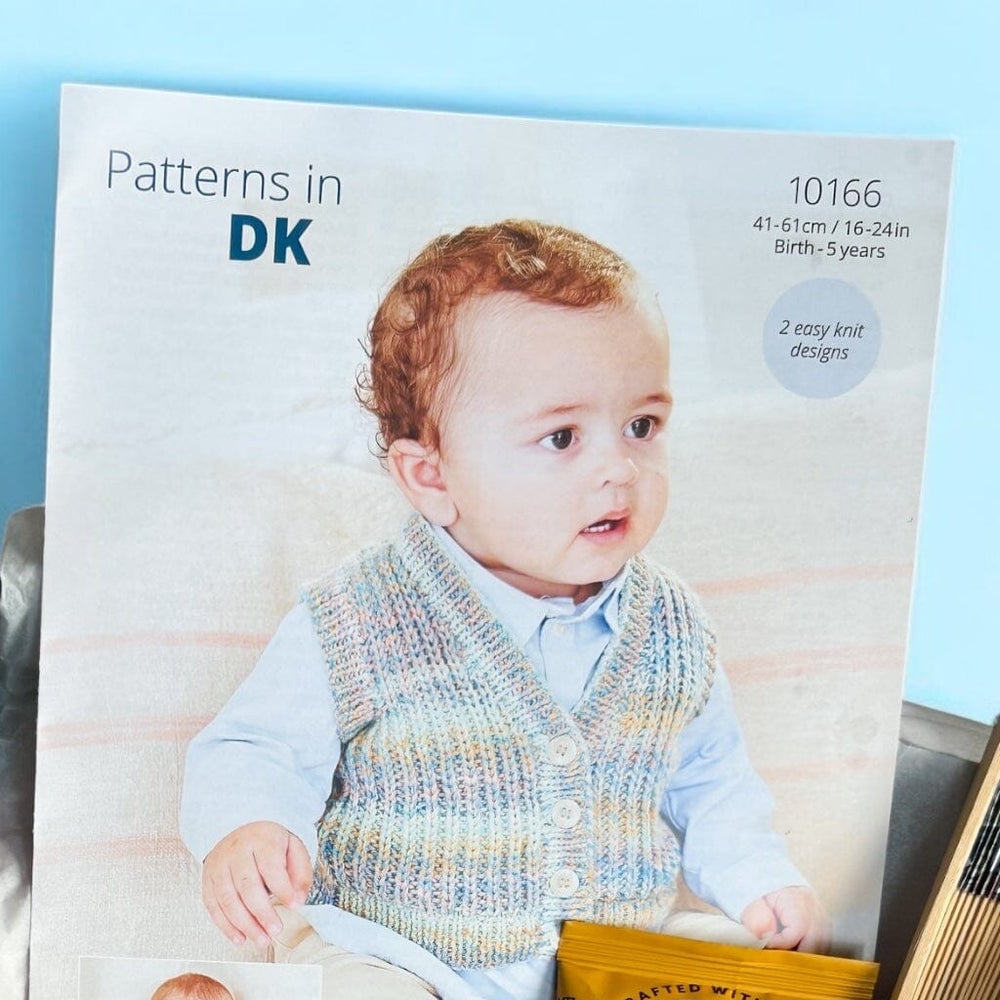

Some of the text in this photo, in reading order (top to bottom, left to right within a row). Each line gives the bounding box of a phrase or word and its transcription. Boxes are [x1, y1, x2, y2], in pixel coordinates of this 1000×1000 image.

[107, 149, 342, 205] Patterns in
[789, 176, 882, 208] 10166
[752, 216, 827, 235] 41-61cm
[844, 220, 910, 238] 16-24in
[228, 213, 314, 266] DK
[838, 244, 886, 261] years
[778, 320, 865, 341] 2 easy knit
[790, 342, 849, 363] designs
